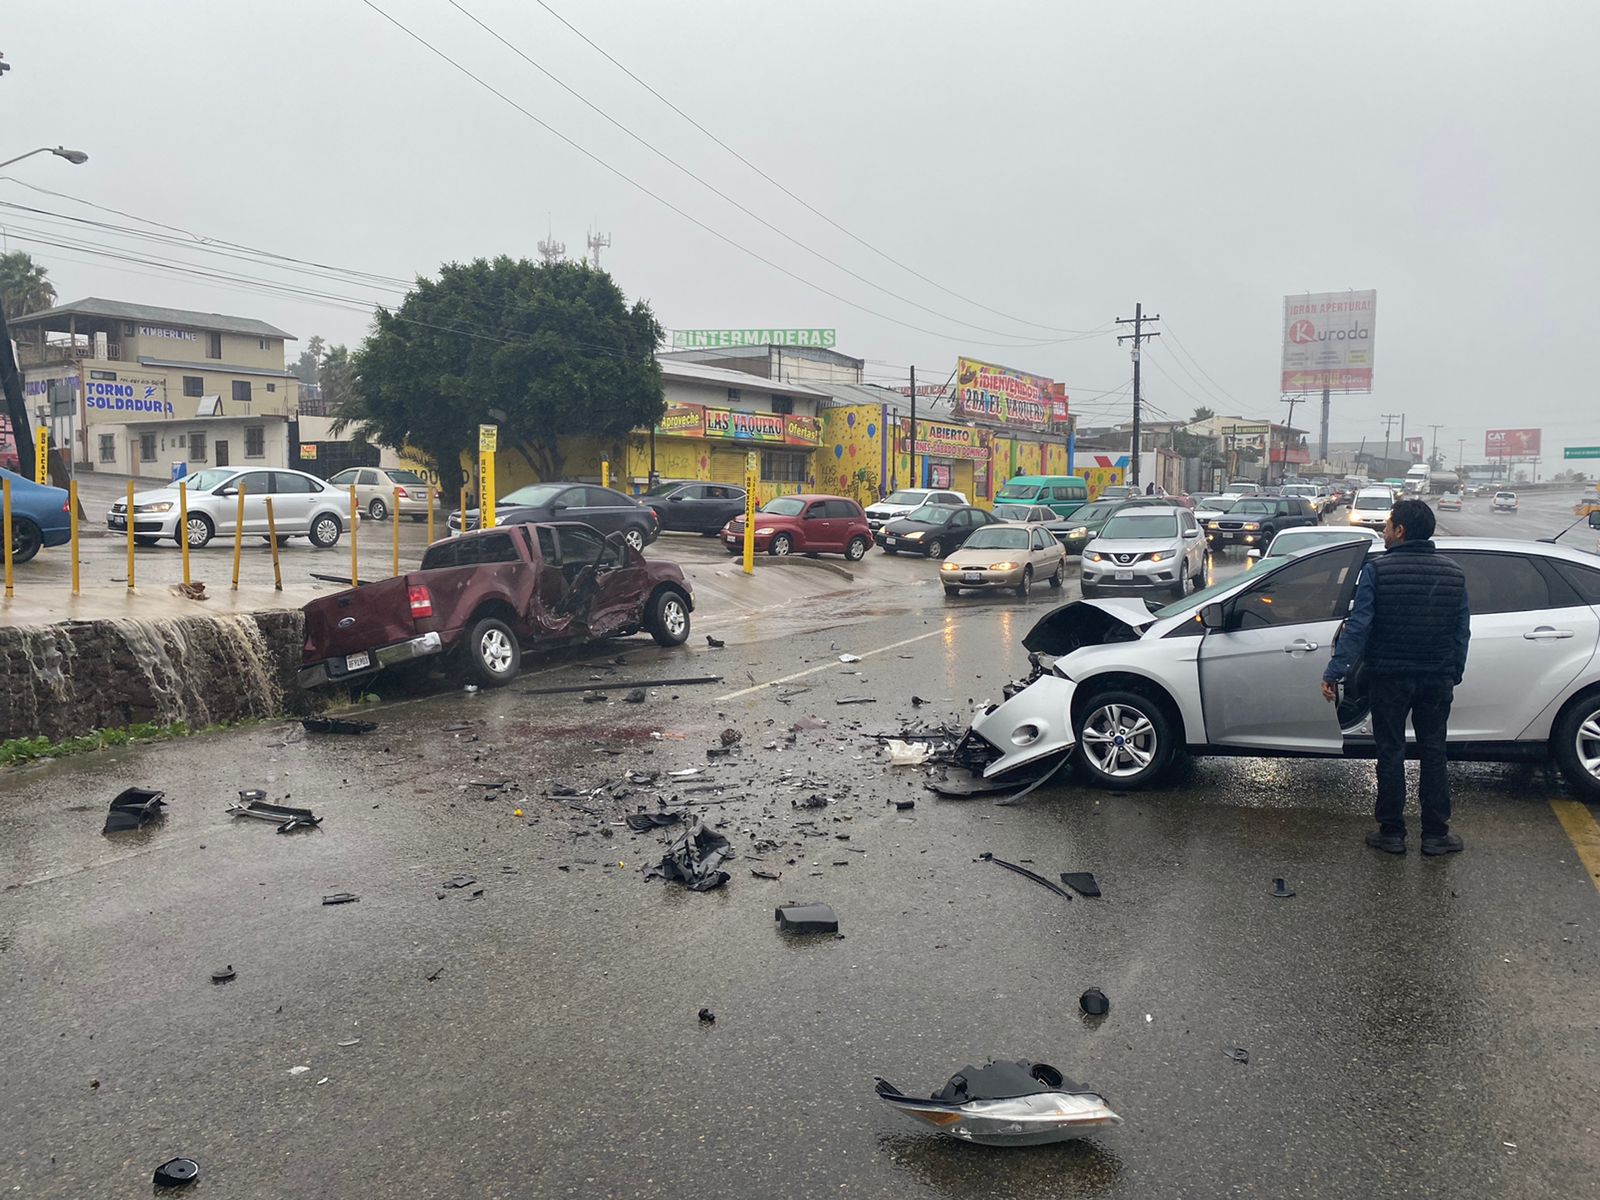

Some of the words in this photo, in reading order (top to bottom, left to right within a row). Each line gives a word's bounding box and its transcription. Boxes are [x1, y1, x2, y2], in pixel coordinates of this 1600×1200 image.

[139, 326, 197, 341] KIMBERLINE
[688, 330, 833, 345] INTERMADERAS
[1289, 320, 1368, 345] Kuroda
[86, 383, 133, 397] TORNO
[86, 397, 173, 413] SOLDADURA
[661, 412, 699, 428] Aproveche
[706, 412, 729, 430] LAS
[732, 415, 782, 434] VAQUERO
[788, 422, 818, 440] Ofertas!
[929, 426, 969, 442] ABIERTO
[1487, 432, 1506, 441] CAT
